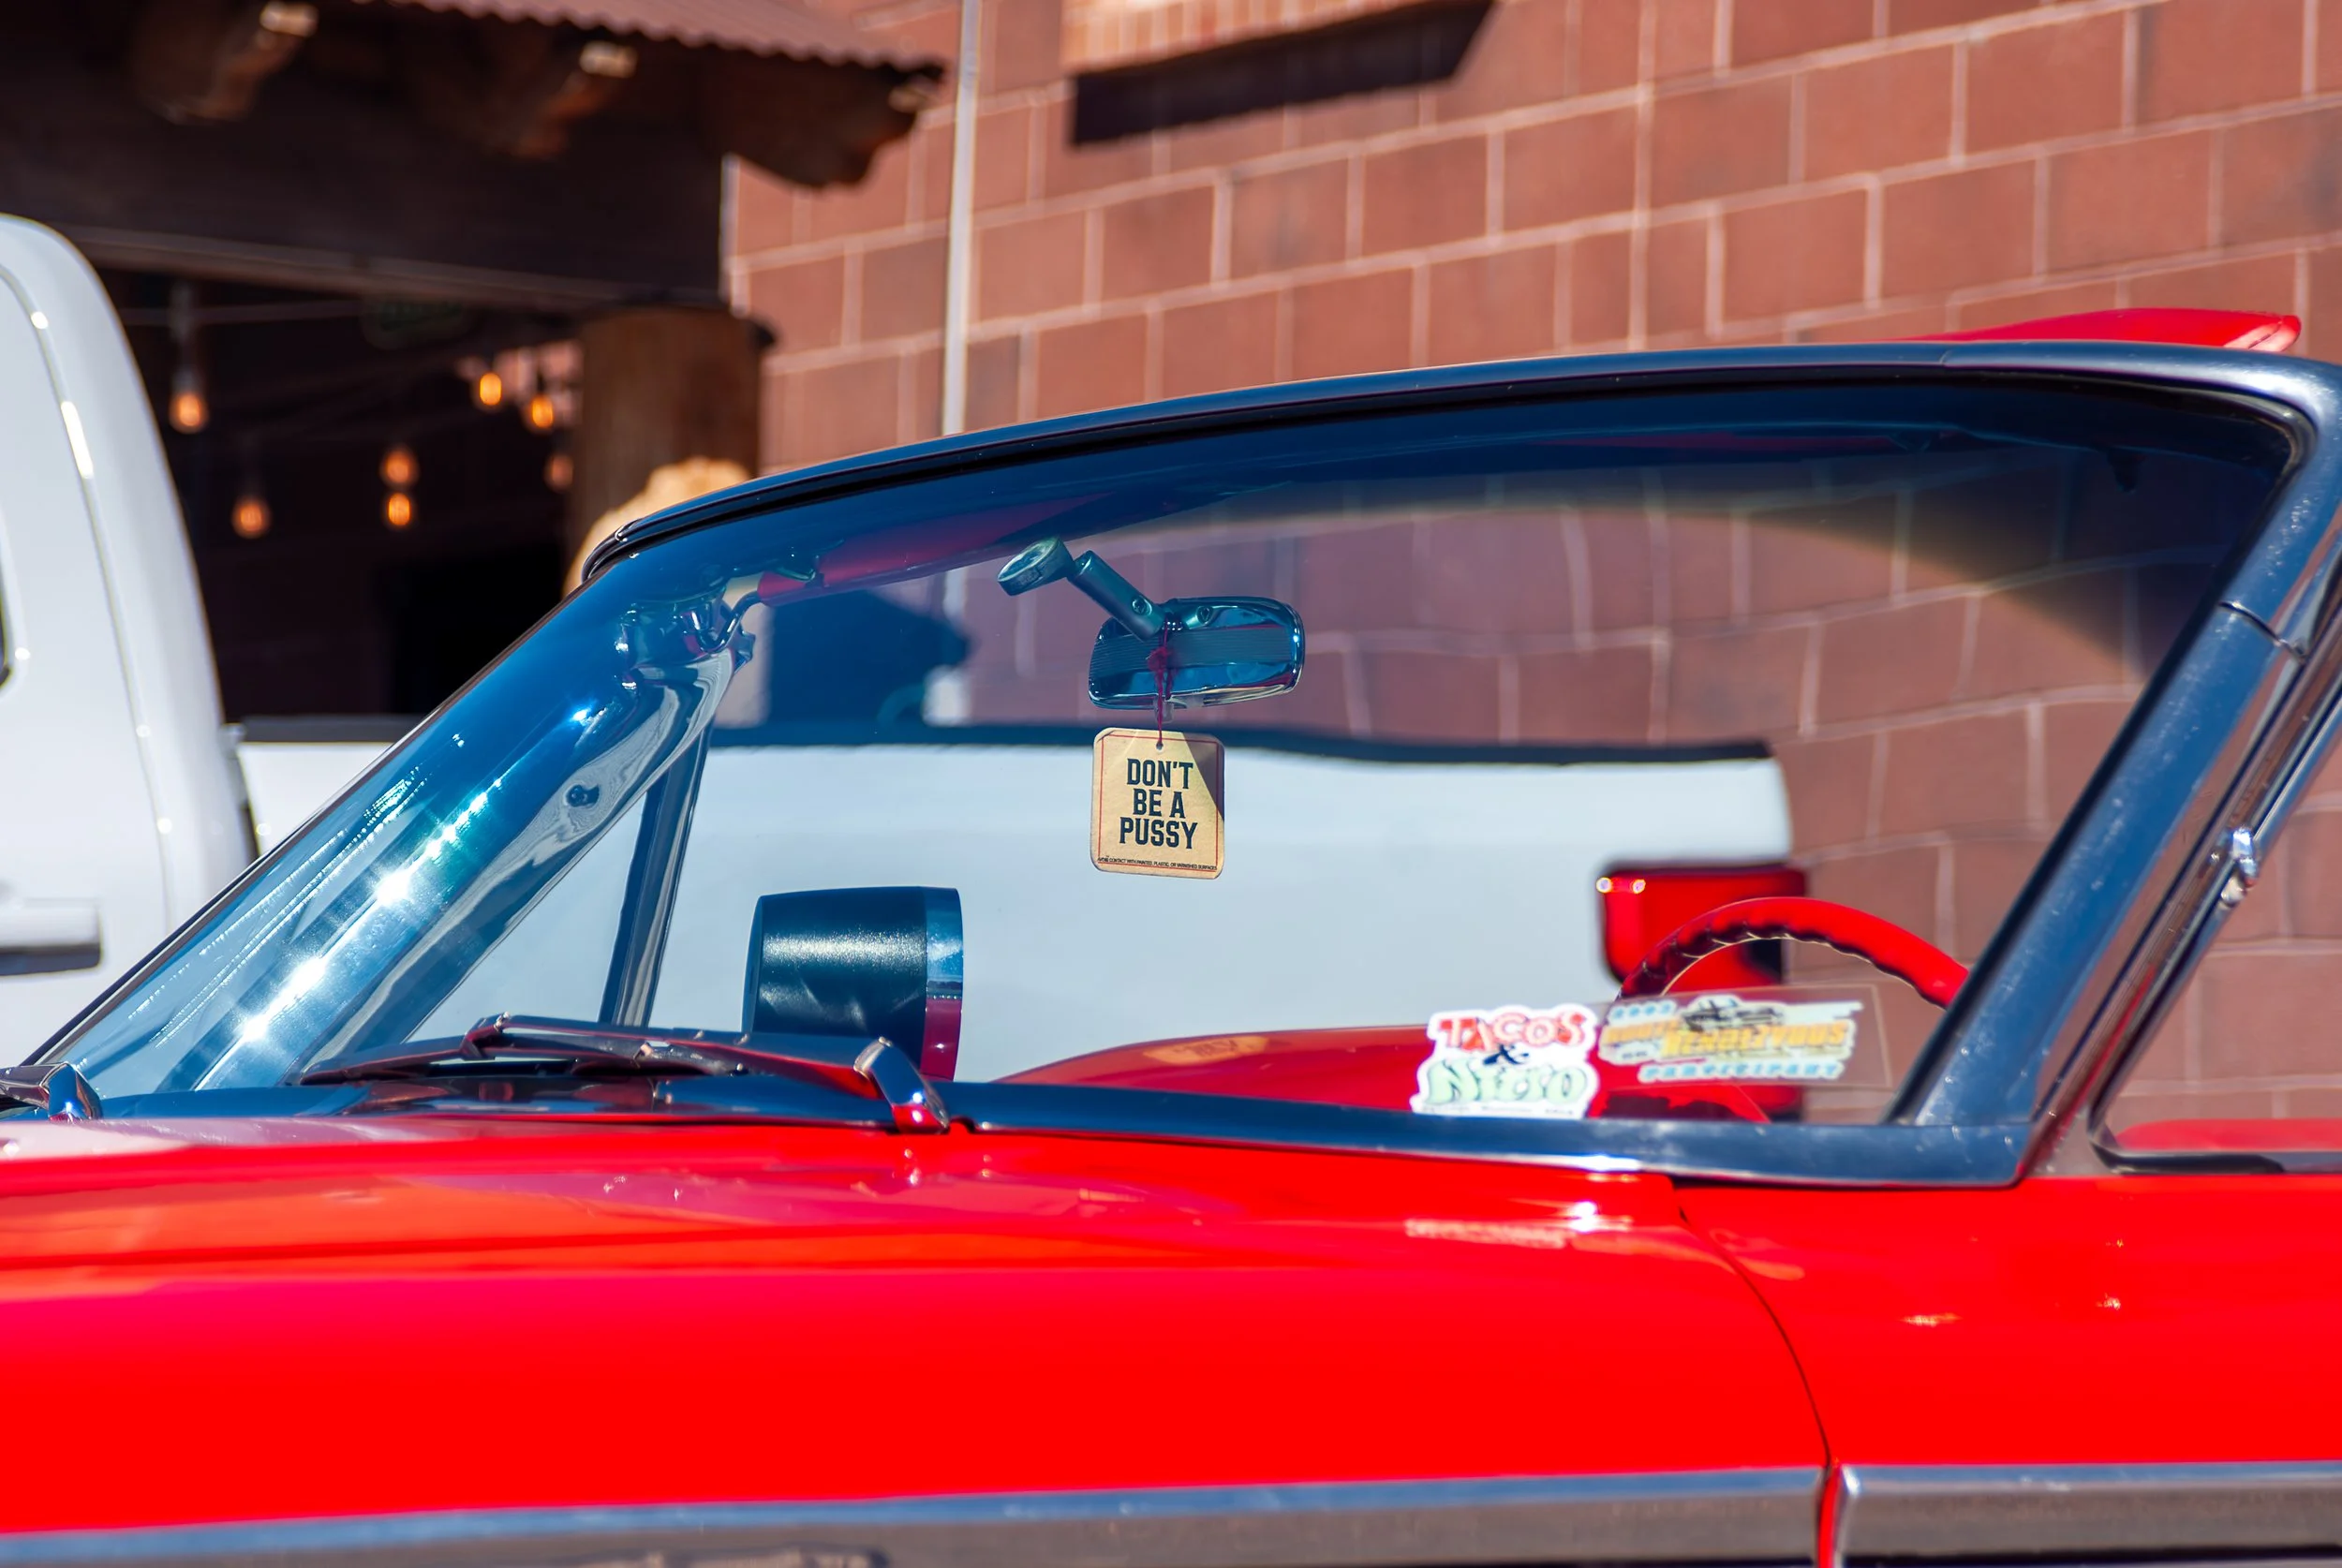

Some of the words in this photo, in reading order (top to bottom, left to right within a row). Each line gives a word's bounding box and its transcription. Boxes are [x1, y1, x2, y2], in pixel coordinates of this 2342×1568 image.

[1127, 758, 1193, 789] DON'T
[1133, 788, 1163, 817] BE
[1169, 791, 1185, 819] A
[1119, 817, 1197, 850] PUSSY
[1439, 1012, 1585, 1052] TACOS
